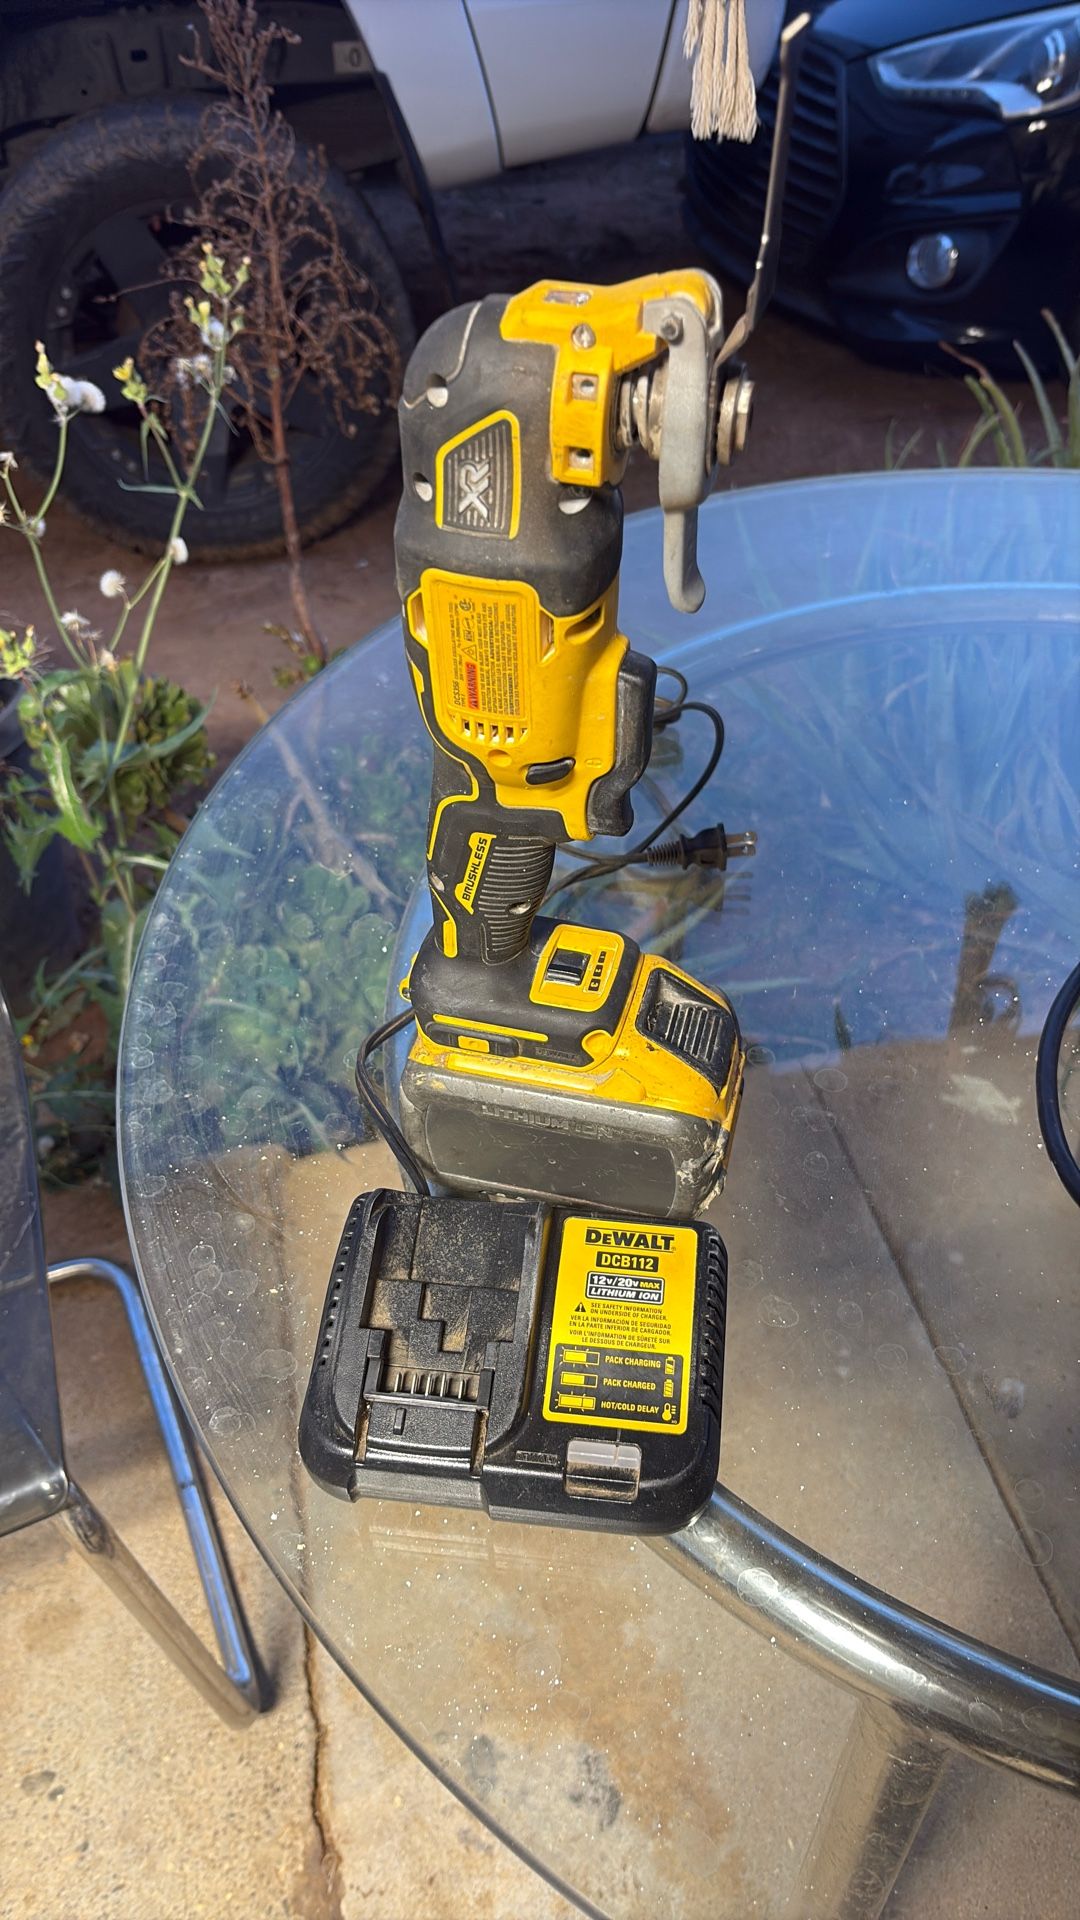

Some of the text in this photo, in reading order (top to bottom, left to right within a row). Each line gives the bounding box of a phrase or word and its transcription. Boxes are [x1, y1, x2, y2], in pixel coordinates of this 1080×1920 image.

[459, 461, 490, 521] XR
[466, 663, 477, 699] WARNING
[462, 838, 487, 901] BRUSHLESS
[601, 1254, 654, 1269] DCB112
[640, 1281, 660, 1289] MAX
[590, 1287, 660, 1301] LITHIUM ION
[624, 1305, 662, 1314] INFORMATION
[584, 1331, 626, 1340] L'INFORMATION
[640, 1328, 671, 1336] CARGADOR.
[605, 1355, 662, 1368] PACK CHARGING
[603, 1378, 656, 1390] PACK CHARGED
[601, 1401, 660, 1414] HOT/COLD DELAY
